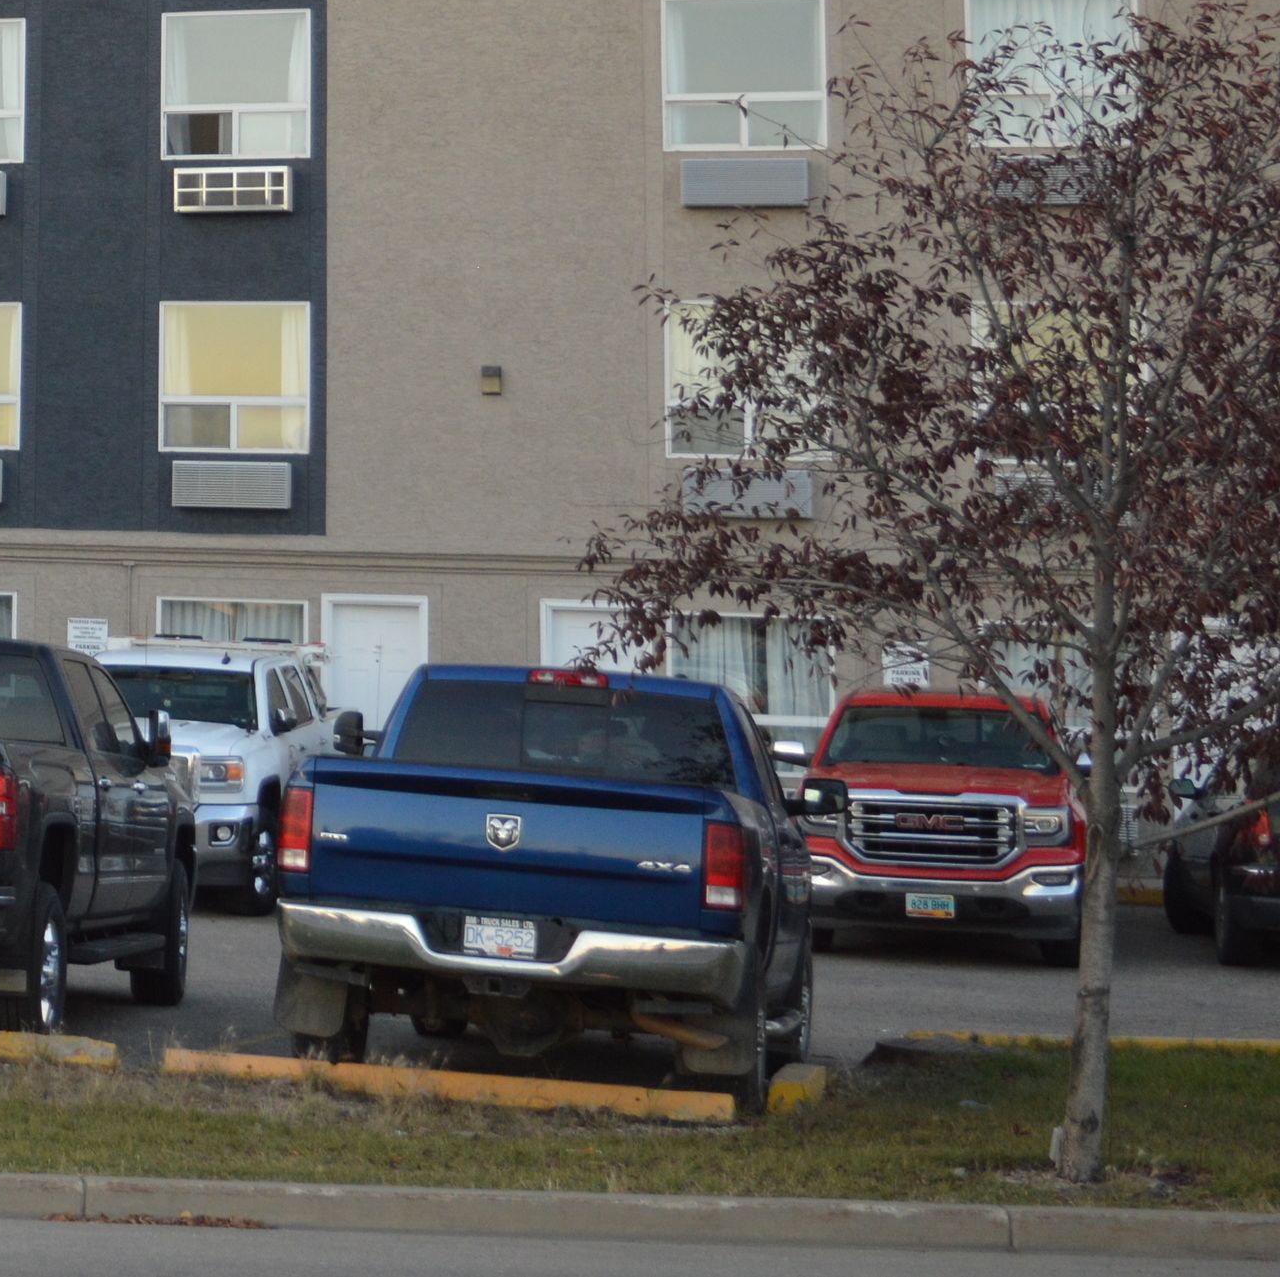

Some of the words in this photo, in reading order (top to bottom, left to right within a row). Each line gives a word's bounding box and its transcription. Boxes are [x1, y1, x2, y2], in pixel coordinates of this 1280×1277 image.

[895, 812, 964, 831] GMC
[481, 917, 500, 926] TRUCK
[501, 918, 520, 928] SALES
[465, 926, 485, 946] DK
[494, 928, 534, 949] 5252
